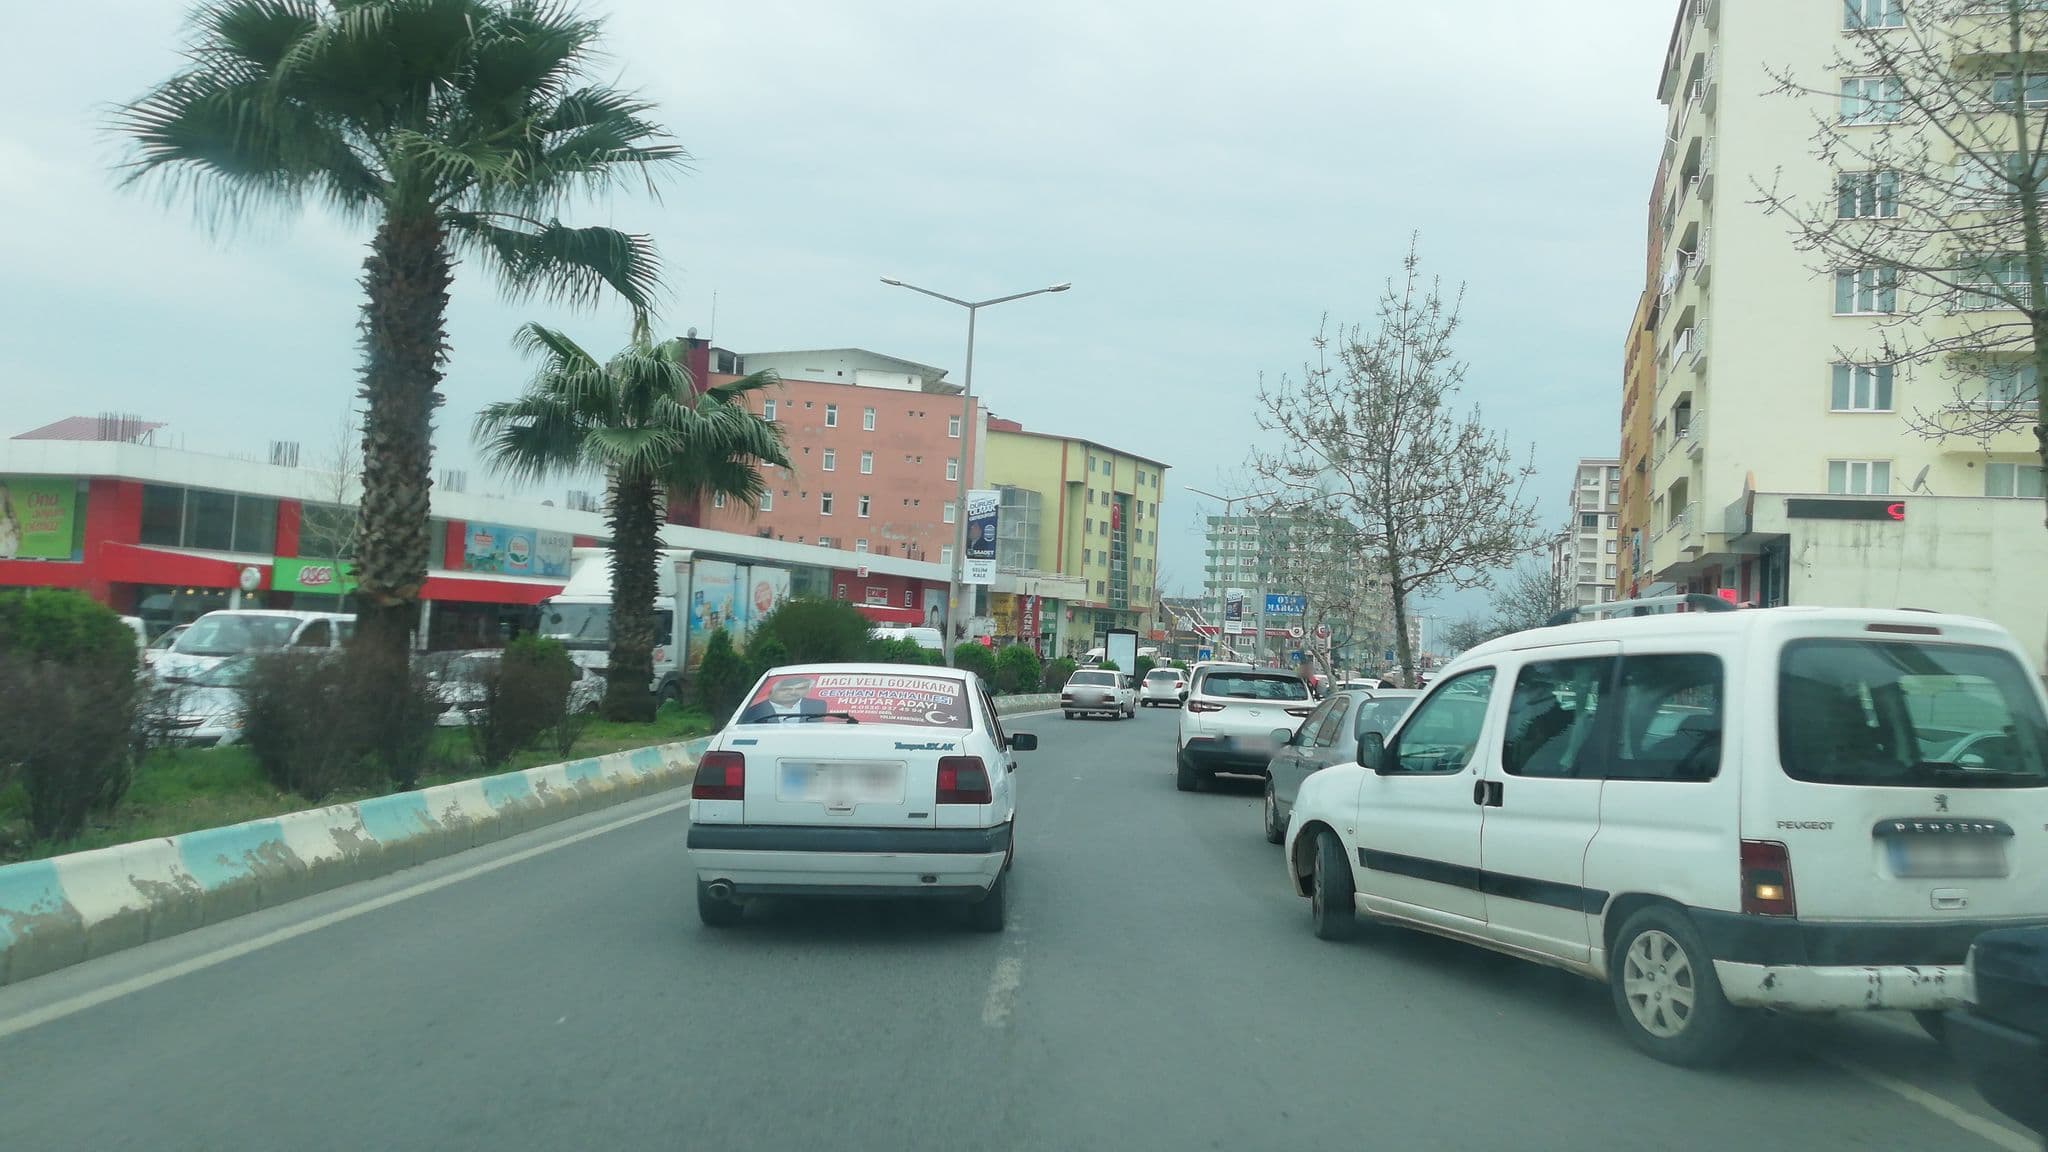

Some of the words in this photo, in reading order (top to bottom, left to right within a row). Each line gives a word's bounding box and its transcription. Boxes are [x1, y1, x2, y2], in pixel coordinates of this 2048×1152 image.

[819, 688, 875, 698] CEYHAN
[837, 697, 894, 706] MUHTAR
[896, 699, 938, 710] ADAYI
[1776, 820, 1835, 830] PEUGEOT
[1894, 822, 1997, 833] PEUGEOT
